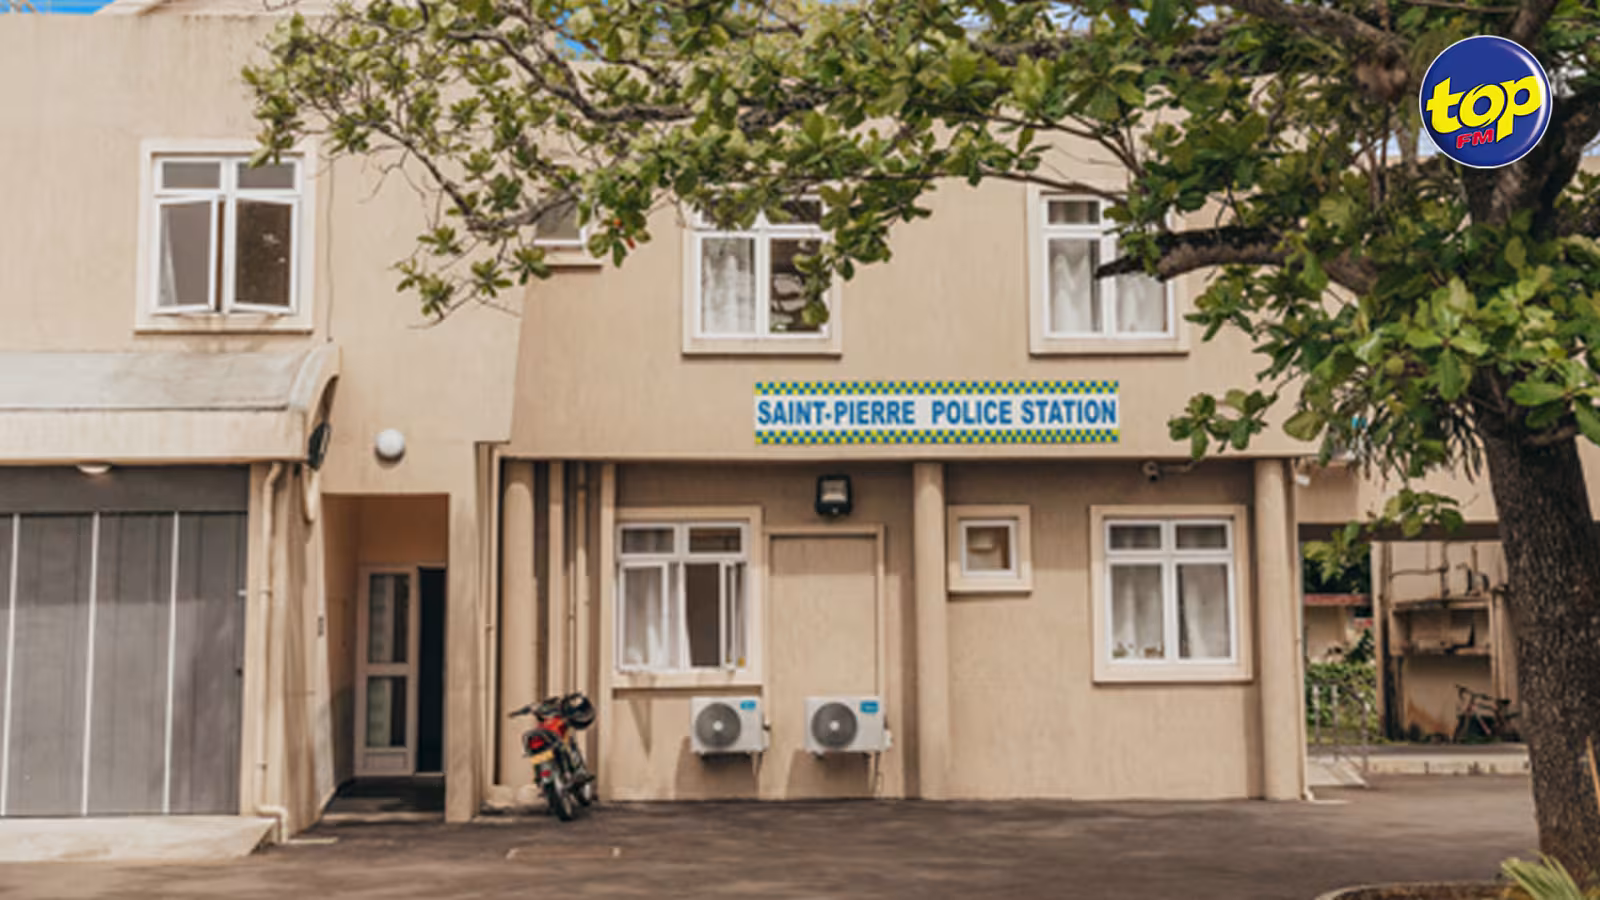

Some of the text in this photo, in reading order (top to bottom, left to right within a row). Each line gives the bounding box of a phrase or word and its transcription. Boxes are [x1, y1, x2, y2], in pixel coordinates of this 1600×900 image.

[757, 400, 1117, 425] SAINT-PIERRE POLICE STATION
